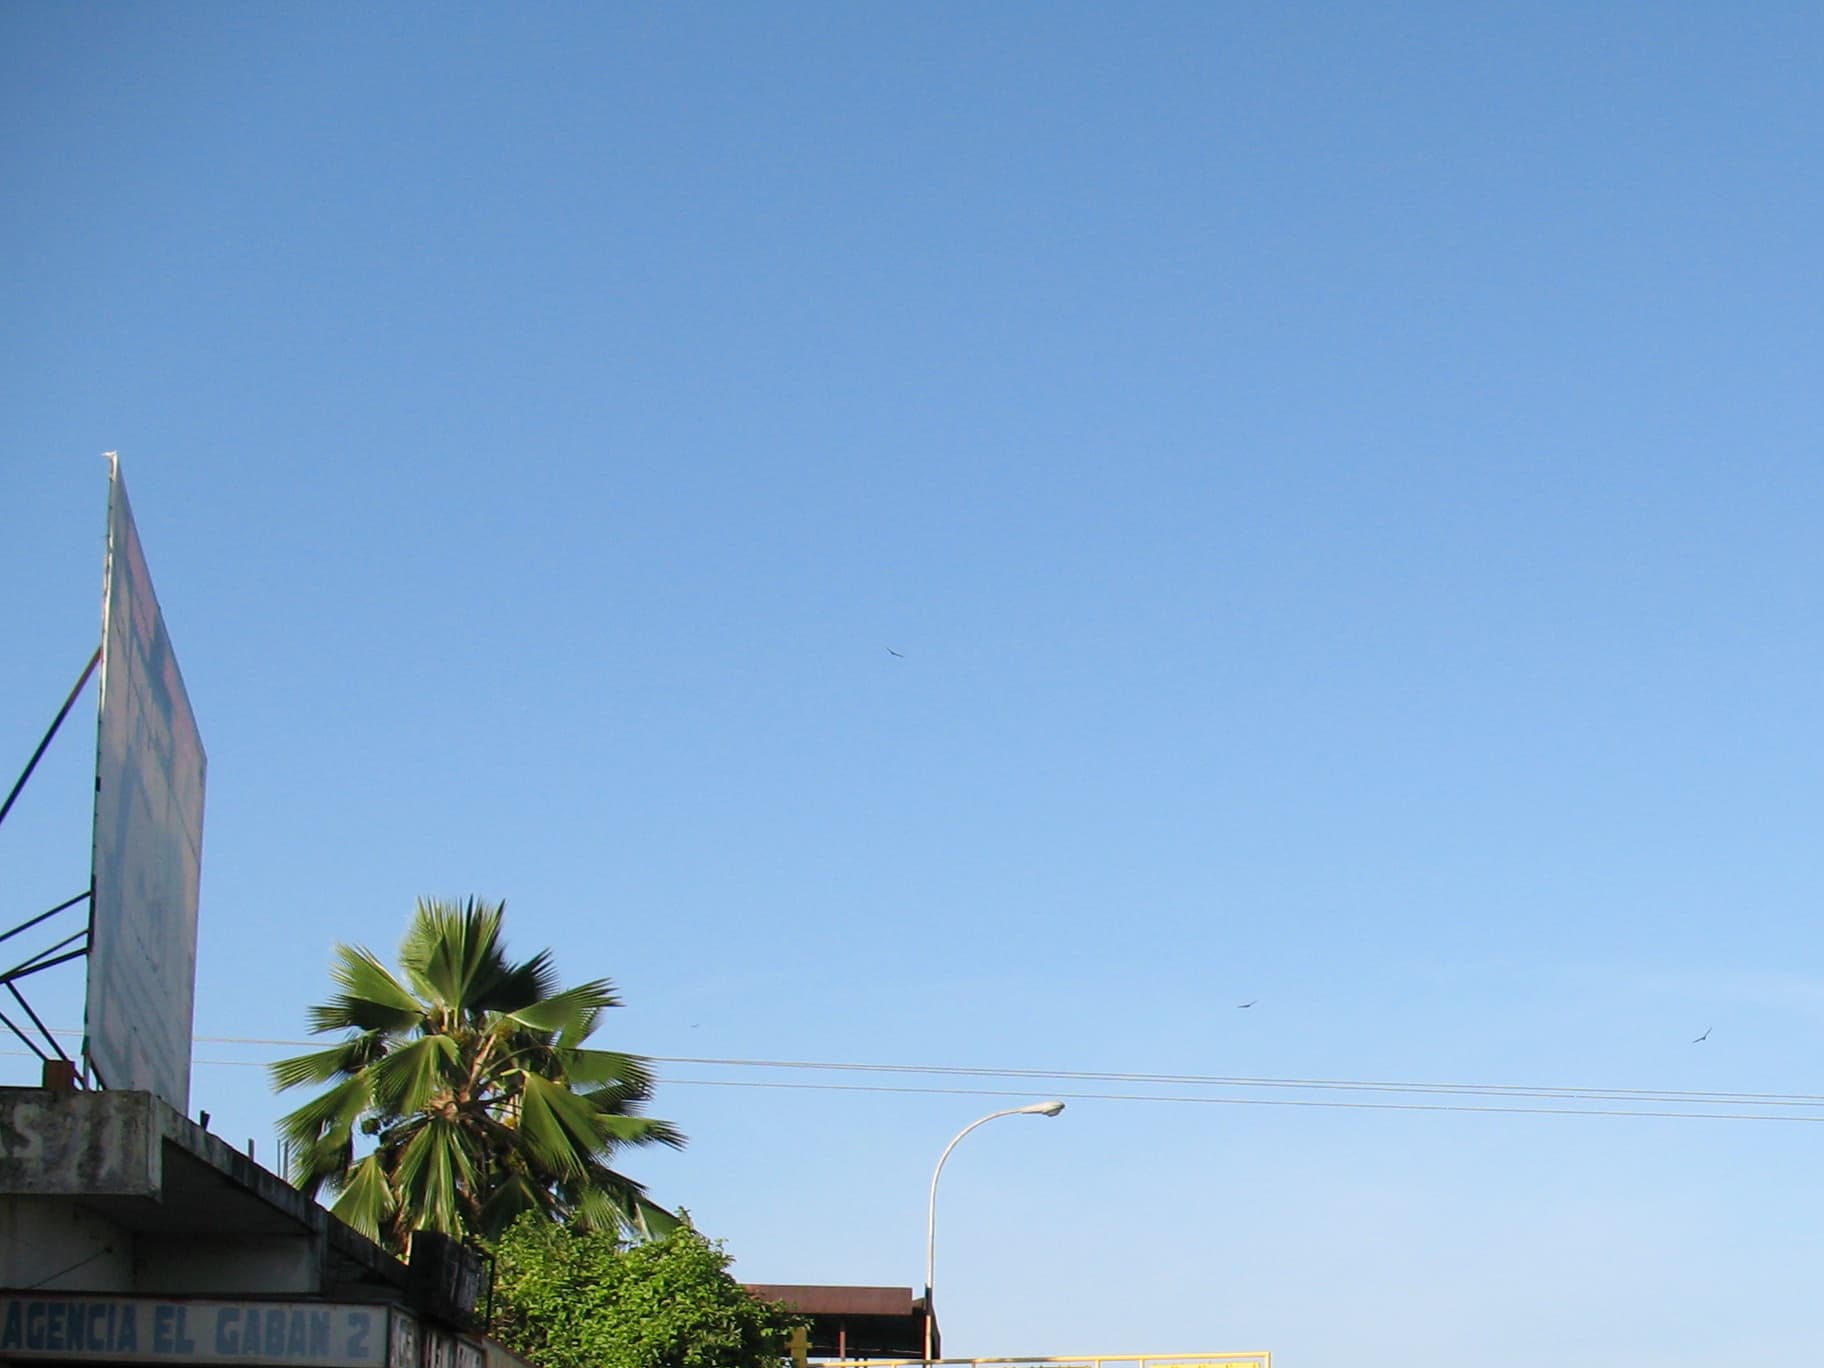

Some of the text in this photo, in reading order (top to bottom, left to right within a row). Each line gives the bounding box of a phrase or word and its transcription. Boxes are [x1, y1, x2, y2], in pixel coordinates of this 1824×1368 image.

[1, 1301, 138, 1350] AGENCIA
[154, 1306, 195, 1354] EL
[216, 1307, 331, 1357] GABAN
[347, 1313, 371, 1358] 2
